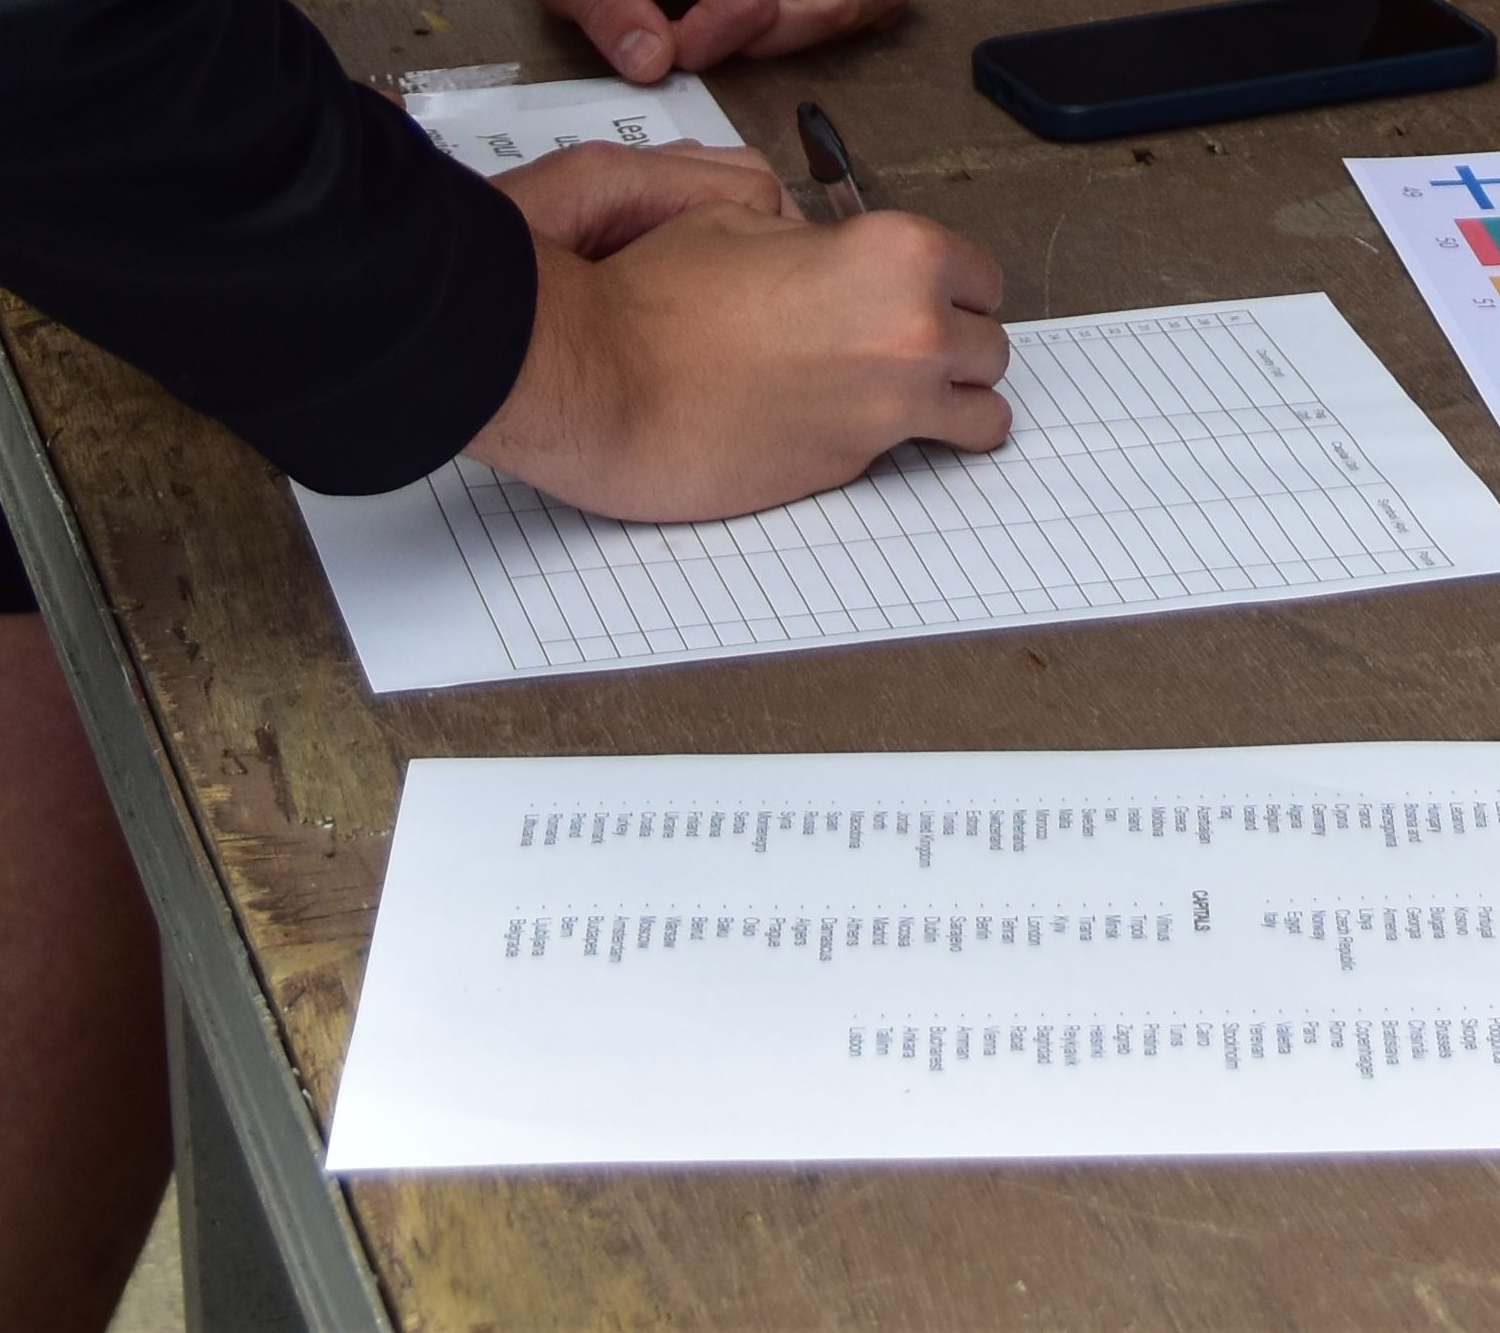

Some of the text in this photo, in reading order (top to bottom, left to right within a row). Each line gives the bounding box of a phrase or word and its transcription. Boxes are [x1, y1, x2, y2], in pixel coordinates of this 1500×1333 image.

[476, 132, 523, 160] your
[611, 115, 651, 148] Leav
[1403, 187, 1423, 197] 49
[1436, 238, 1459, 248] 50
[1473, 299, 1496, 307] 51
[591, 812, 610, 845] Denmark
[612, 812, 633, 836] Turkey
[824, 812, 842, 832] Spain
[1081, 808, 1097, 838] Sweden
[1174, 806, 1190, 833] Greece
[1424, 803, 1442, 833] Hungary
[1449, 802, 1465, 834] Lebanon
[561, 916, 579, 938] Bern
[583, 916, 605, 956] Budapest
[637, 916, 656, 949] Moscow
[663, 916, 682, 949] Warsaw
[742, 917, 760, 937] Oslo
[764, 918, 786, 948] Prague
[791, 917, 811, 946] Algiers
[846, 917, 863, 947] Athens
[872, 917, 889, 946] Madrid
[898, 917, 915, 948] Nicosia
[924, 916, 941, 943] Dublin
[946, 916, 967, 953] Sarajevo
[976, 916, 993, 940] Berlin
[1001, 916, 1019, 944] Tehran
[1027, 916, 1043, 946] London
[1310, 910, 1326, 941] Norway
[1383, 908, 1398, 941] Armenia
[1404, 907, 1423, 939] Georgia
[1454, 907, 1469, 936] Kosovo
[1476, 906, 1495, 939] Portugal
[504, 919, 527, 958] Belgrade
[530, 918, 551, 957] Ljubljana
[609, 915, 630, 963] Amsterdam
[819, 918, 838, 962] Damascus
[849, 1027, 865, 1057] Lisbon
[876, 1027, 894, 1056] Tallinn
[902, 1027, 919, 1059] Ankara
[956, 1026, 972, 1060] Amman
[983, 1026, 1000, 1057] Vienna
[1010, 1026, 1027, 1052] Rabat
[1032, 1025, 1054, 1065] Baghdad
[1060, 1025, 1081, 1066] Reykjavik
[1090, 1025, 1105, 1058] Helsinki
[1112, 1024, 1133, 1055] Zagreb
[1143, 1024, 1160, 1057] Pristina
[1170, 1023, 1187, 1047] Tunis
[1196, 1023, 1213, 1047] Cairo
[1222, 1023, 1241, 1070] Stockholm
[1249, 1022, 1266, 1059] Yerevan
[1276, 1022, 1293, 1055] Valletta
[1303, 1021, 1319, 1045] Paris
[1329, 1021, 1346, 1049] Rome
[1381, 1020, 1401, 1066] Bratislava
[1434, 1020, 1454, 1059] Brussels
[1460, 1019, 1478, 1051] Skopje
[929, 1026, 947, 1072] Bucharest
[1353, 1021, 1374, 1079] Copenhagen
